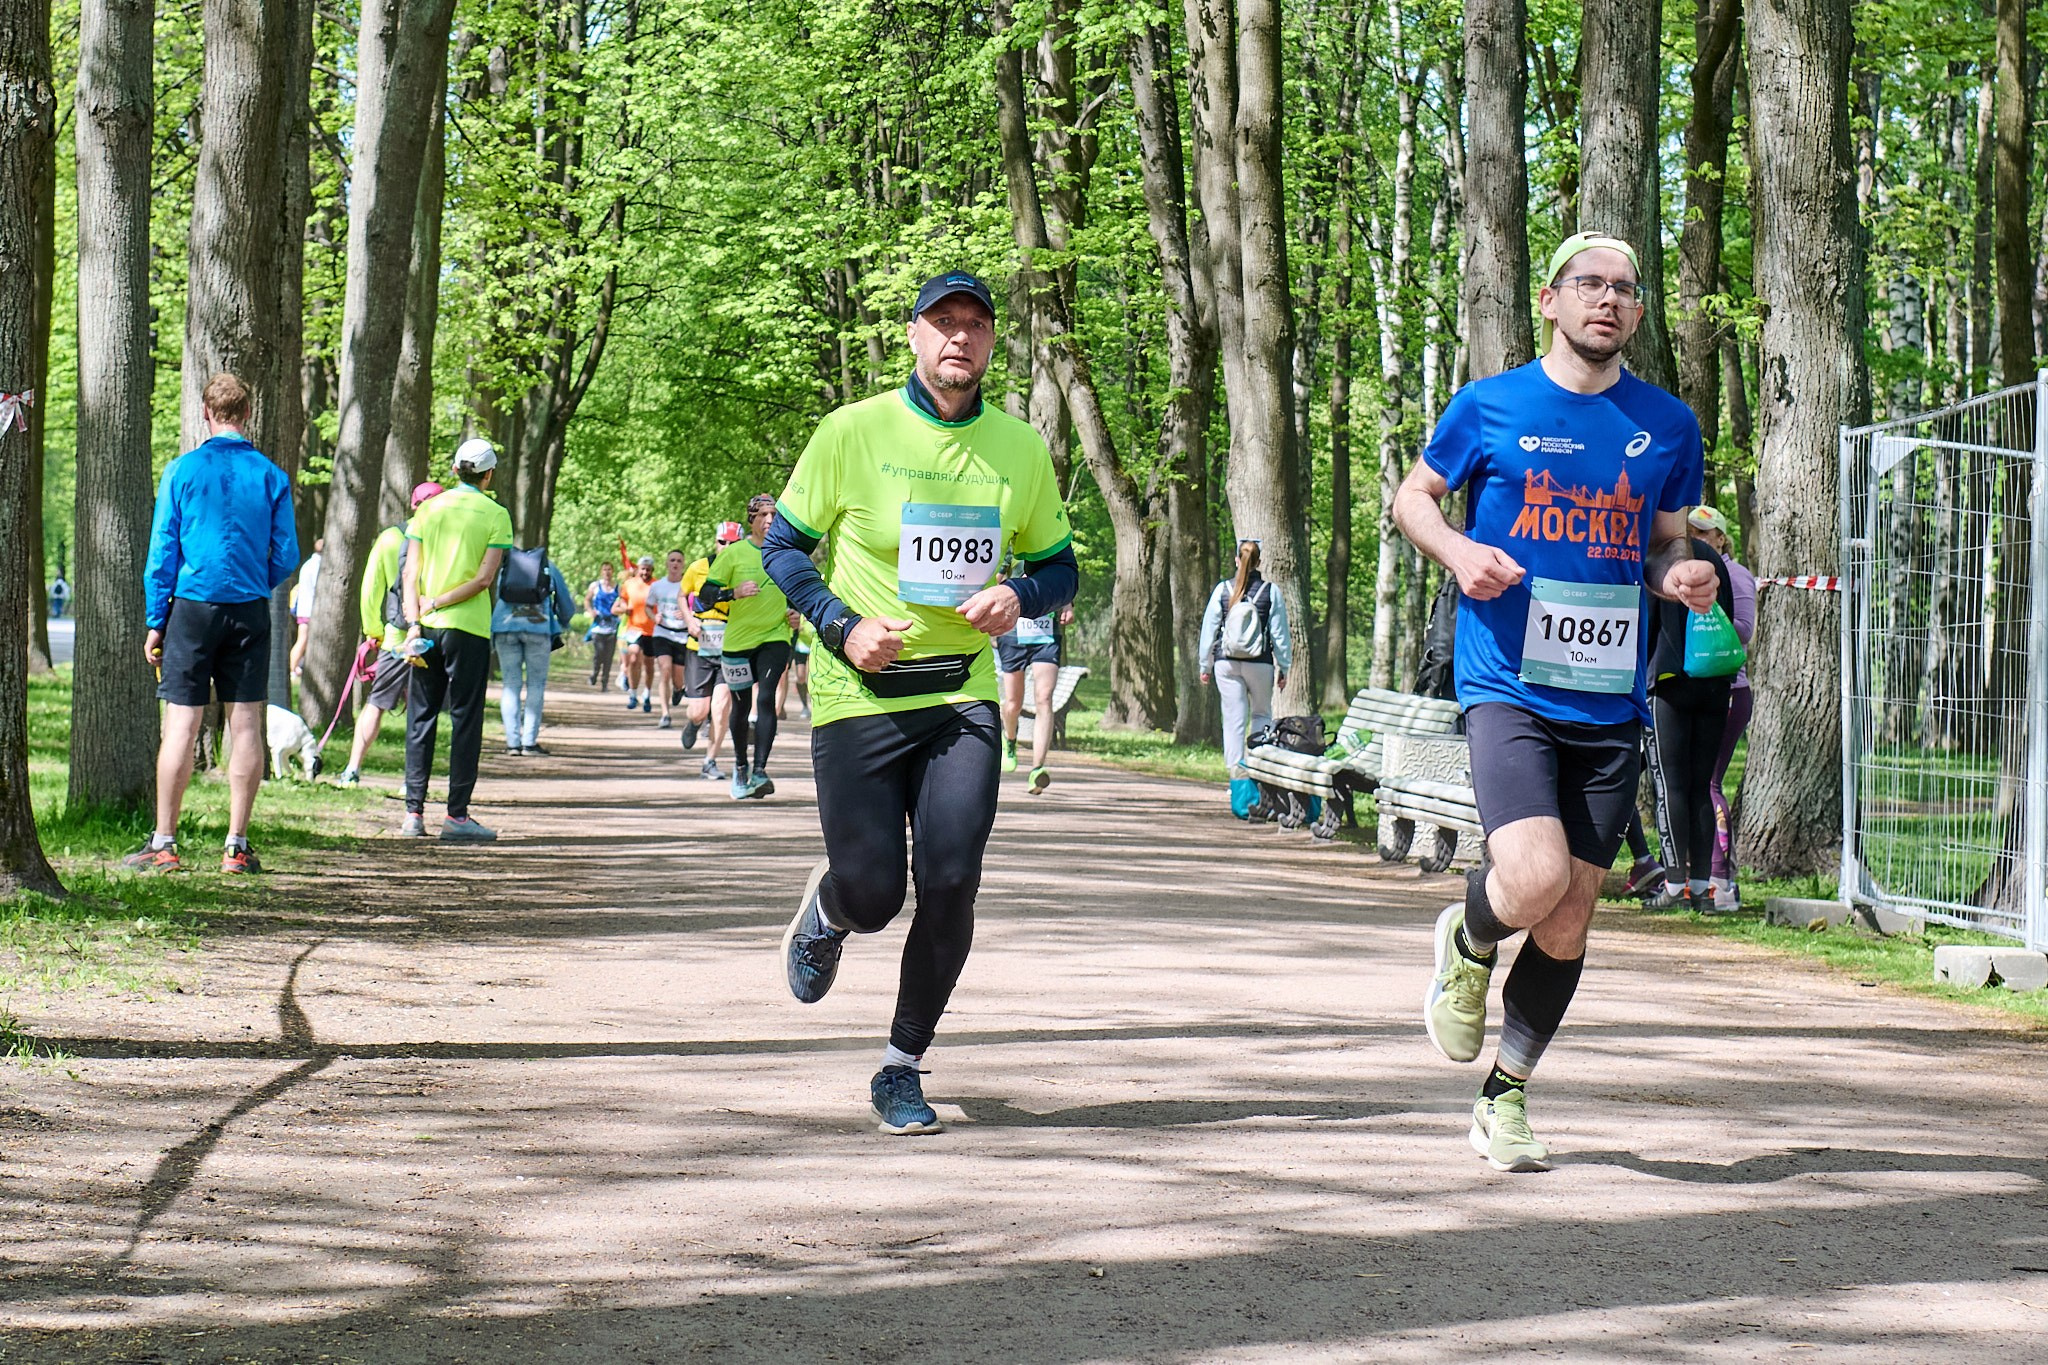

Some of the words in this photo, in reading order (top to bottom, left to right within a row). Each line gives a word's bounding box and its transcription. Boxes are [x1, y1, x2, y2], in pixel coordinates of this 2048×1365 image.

[881, 461, 1010, 486] #управляйбудущим
[1508, 504, 1641, 547] МОСКВА
[911, 536, 994, 564] 10983
[1586, 545, 1641, 563] 22.09.2019
[940, 569, 953, 580] 10
[1021, 619, 1050, 630] 10522
[1540, 613, 1630, 647] 10867
[1570, 650, 1584, 662] 10
